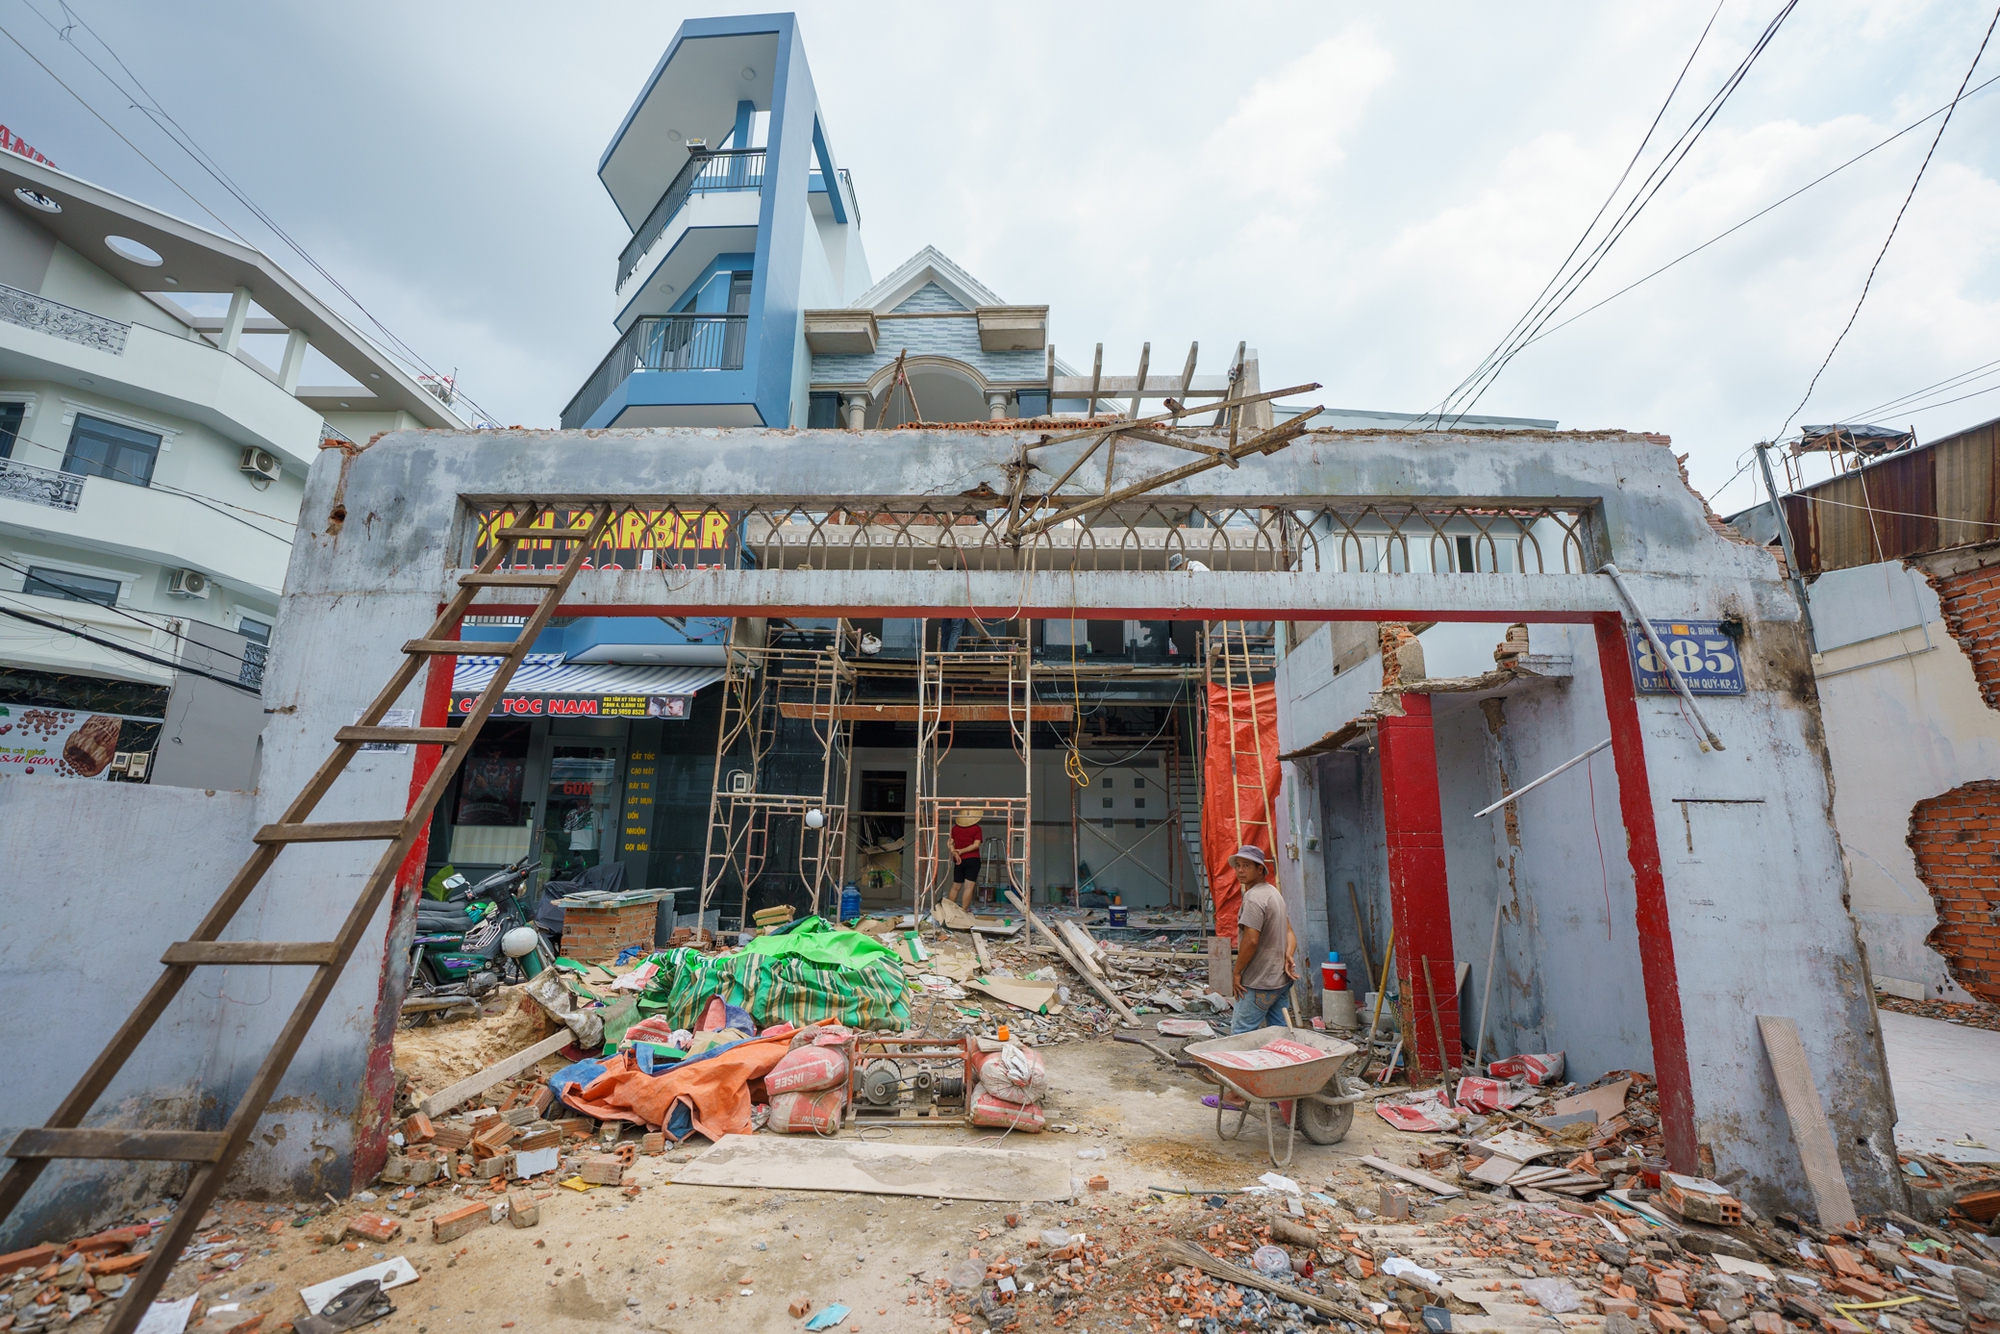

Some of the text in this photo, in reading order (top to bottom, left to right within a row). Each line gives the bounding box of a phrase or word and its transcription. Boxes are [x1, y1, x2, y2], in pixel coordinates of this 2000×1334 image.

[565, 509, 731, 550] BARBER
[1689, 627, 1697, 635] Q.
[1698, 624, 1714, 635] BÌNH
[1637, 640, 1735, 673] 885
[1643, 678, 1652, 688] Đ.
[502, 696, 542, 714] TÓC
[548, 699, 598, 714] NAM
[631, 750, 655, 760] CẮT TÓC
[563, 782, 593, 795] 60K
[1274, 1043, 1312, 1061] INSEE
[775, 1072, 804, 1089] INSEE
